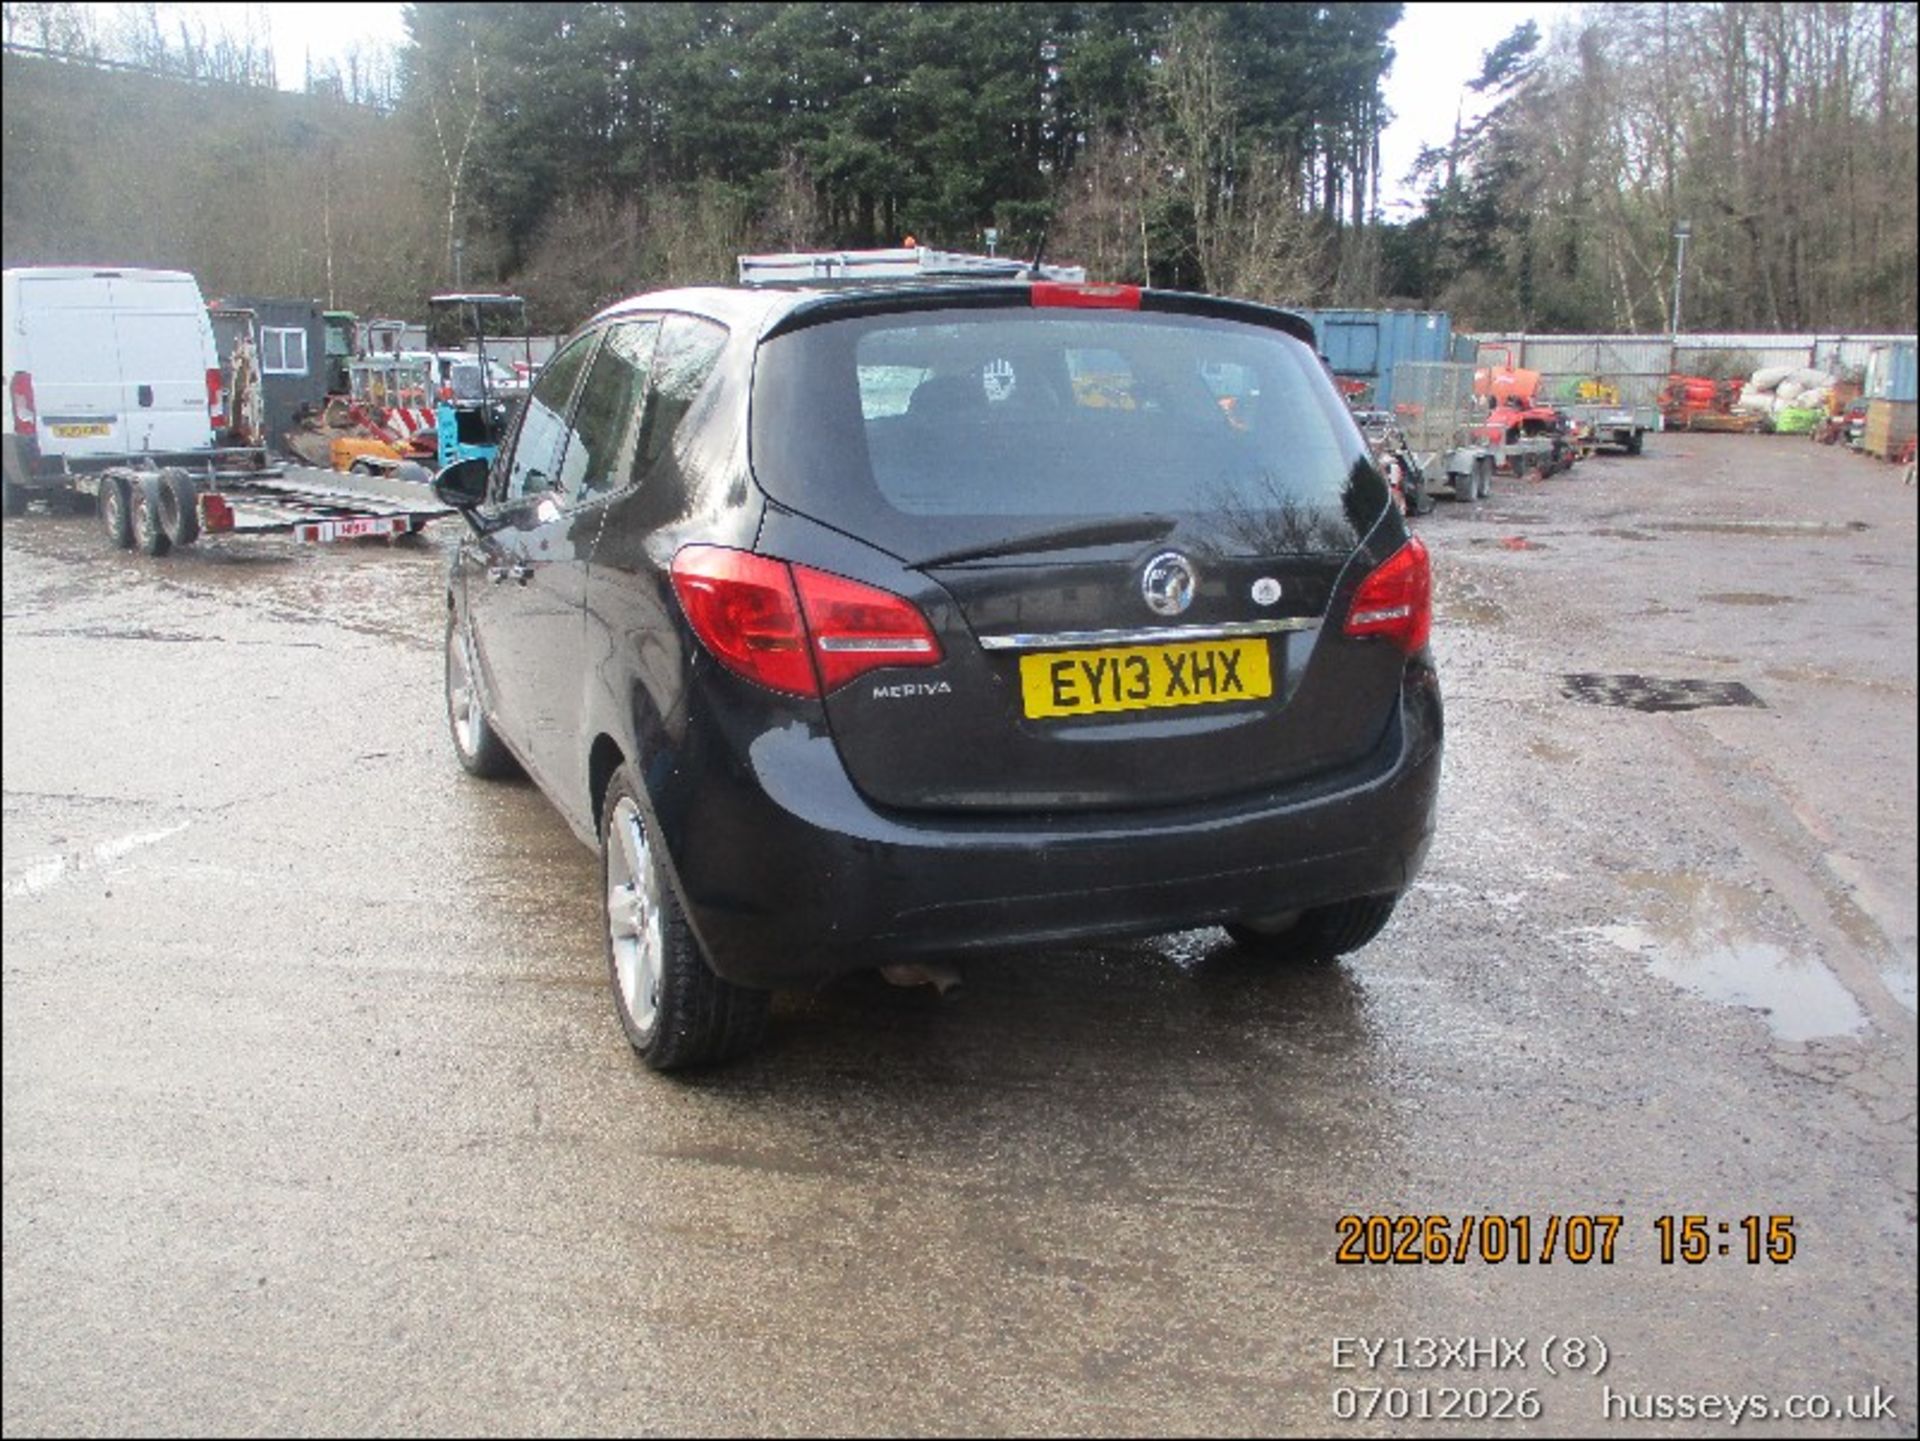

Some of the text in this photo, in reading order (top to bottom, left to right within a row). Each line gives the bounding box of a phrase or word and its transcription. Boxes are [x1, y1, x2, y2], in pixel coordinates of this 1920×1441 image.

[873, 681, 952, 699] MERIVA
[1051, 649, 1244, 708] EY13 XHX
